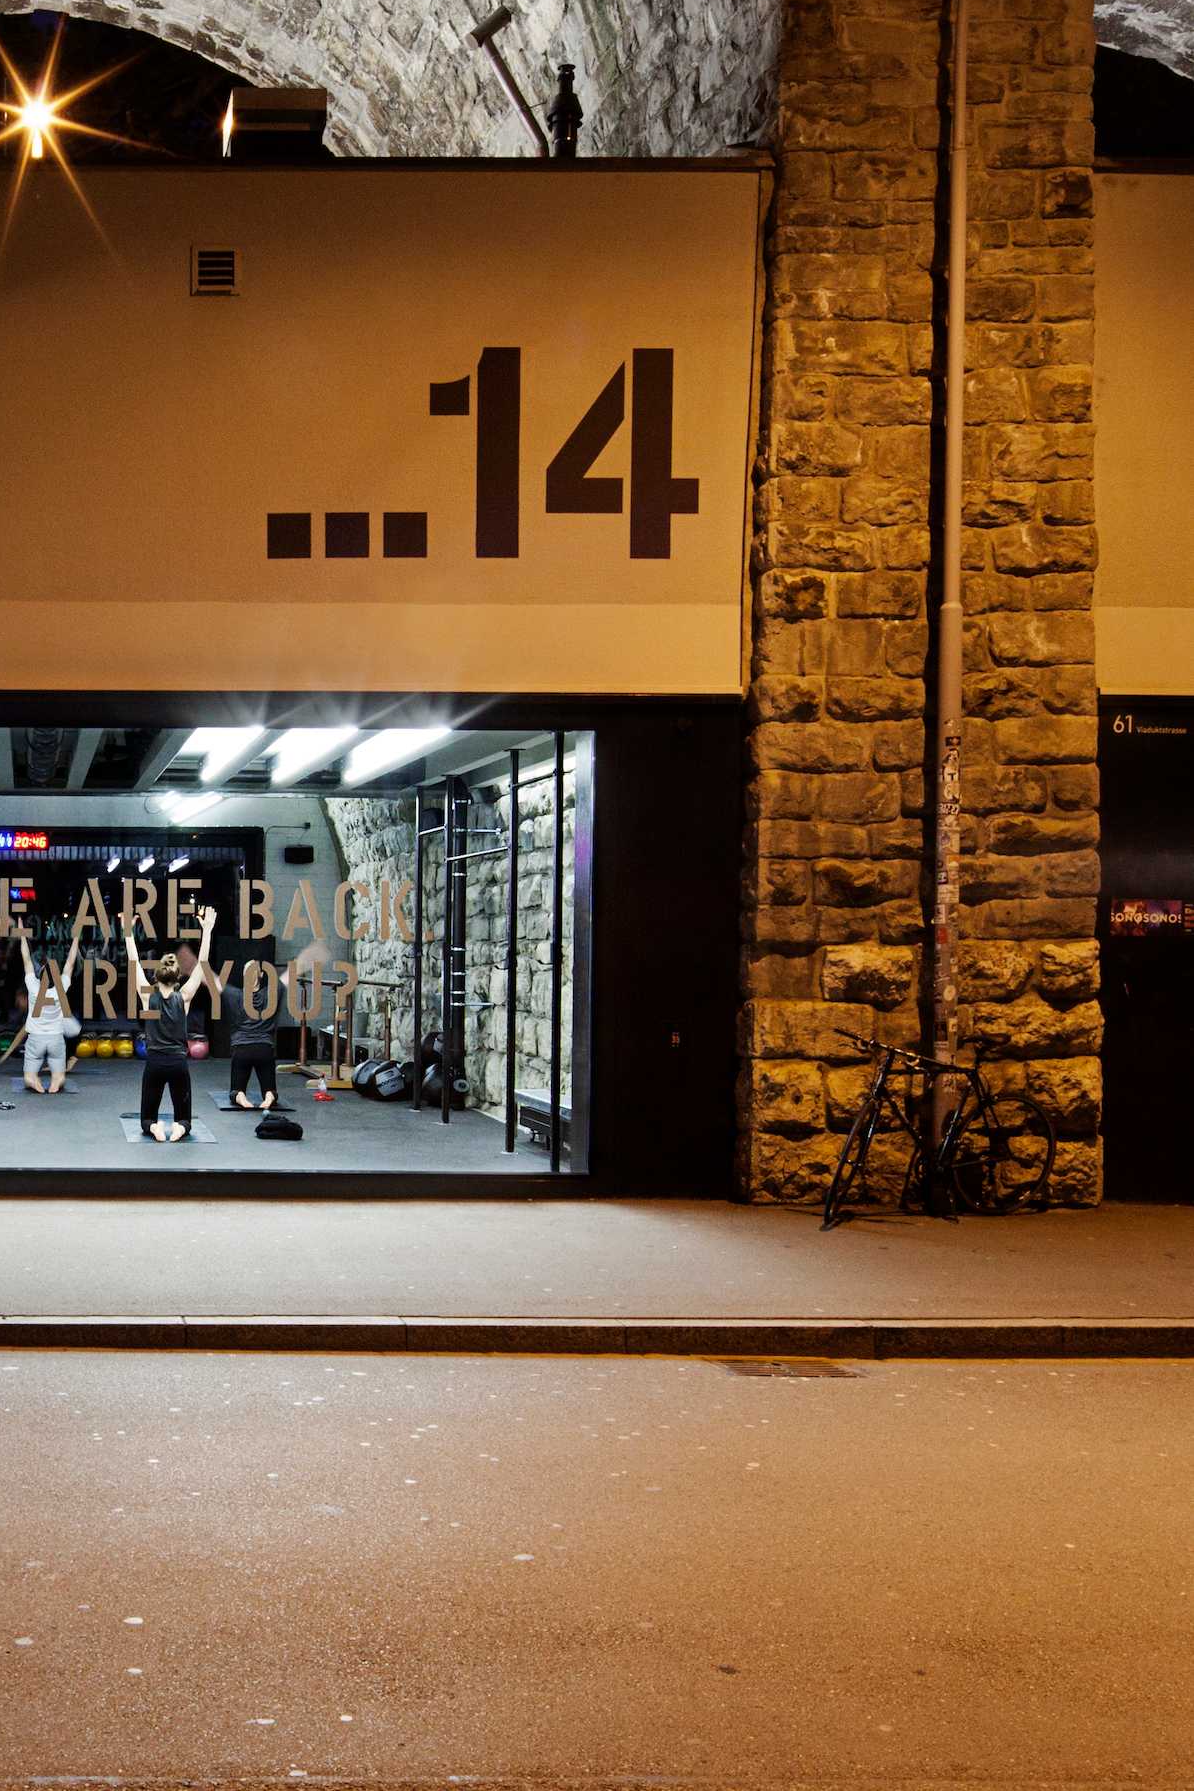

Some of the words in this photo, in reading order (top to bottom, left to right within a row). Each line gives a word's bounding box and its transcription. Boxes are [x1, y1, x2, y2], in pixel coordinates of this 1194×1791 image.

[1113, 713, 1134, 734] 61
[13, 835, 47, 848] 20:46
[71, 878, 203, 939] ARE
[239, 879, 434, 942] BACK.
[32, 960, 161, 1020] ARE
[199, 960, 358, 1022] YOU?
